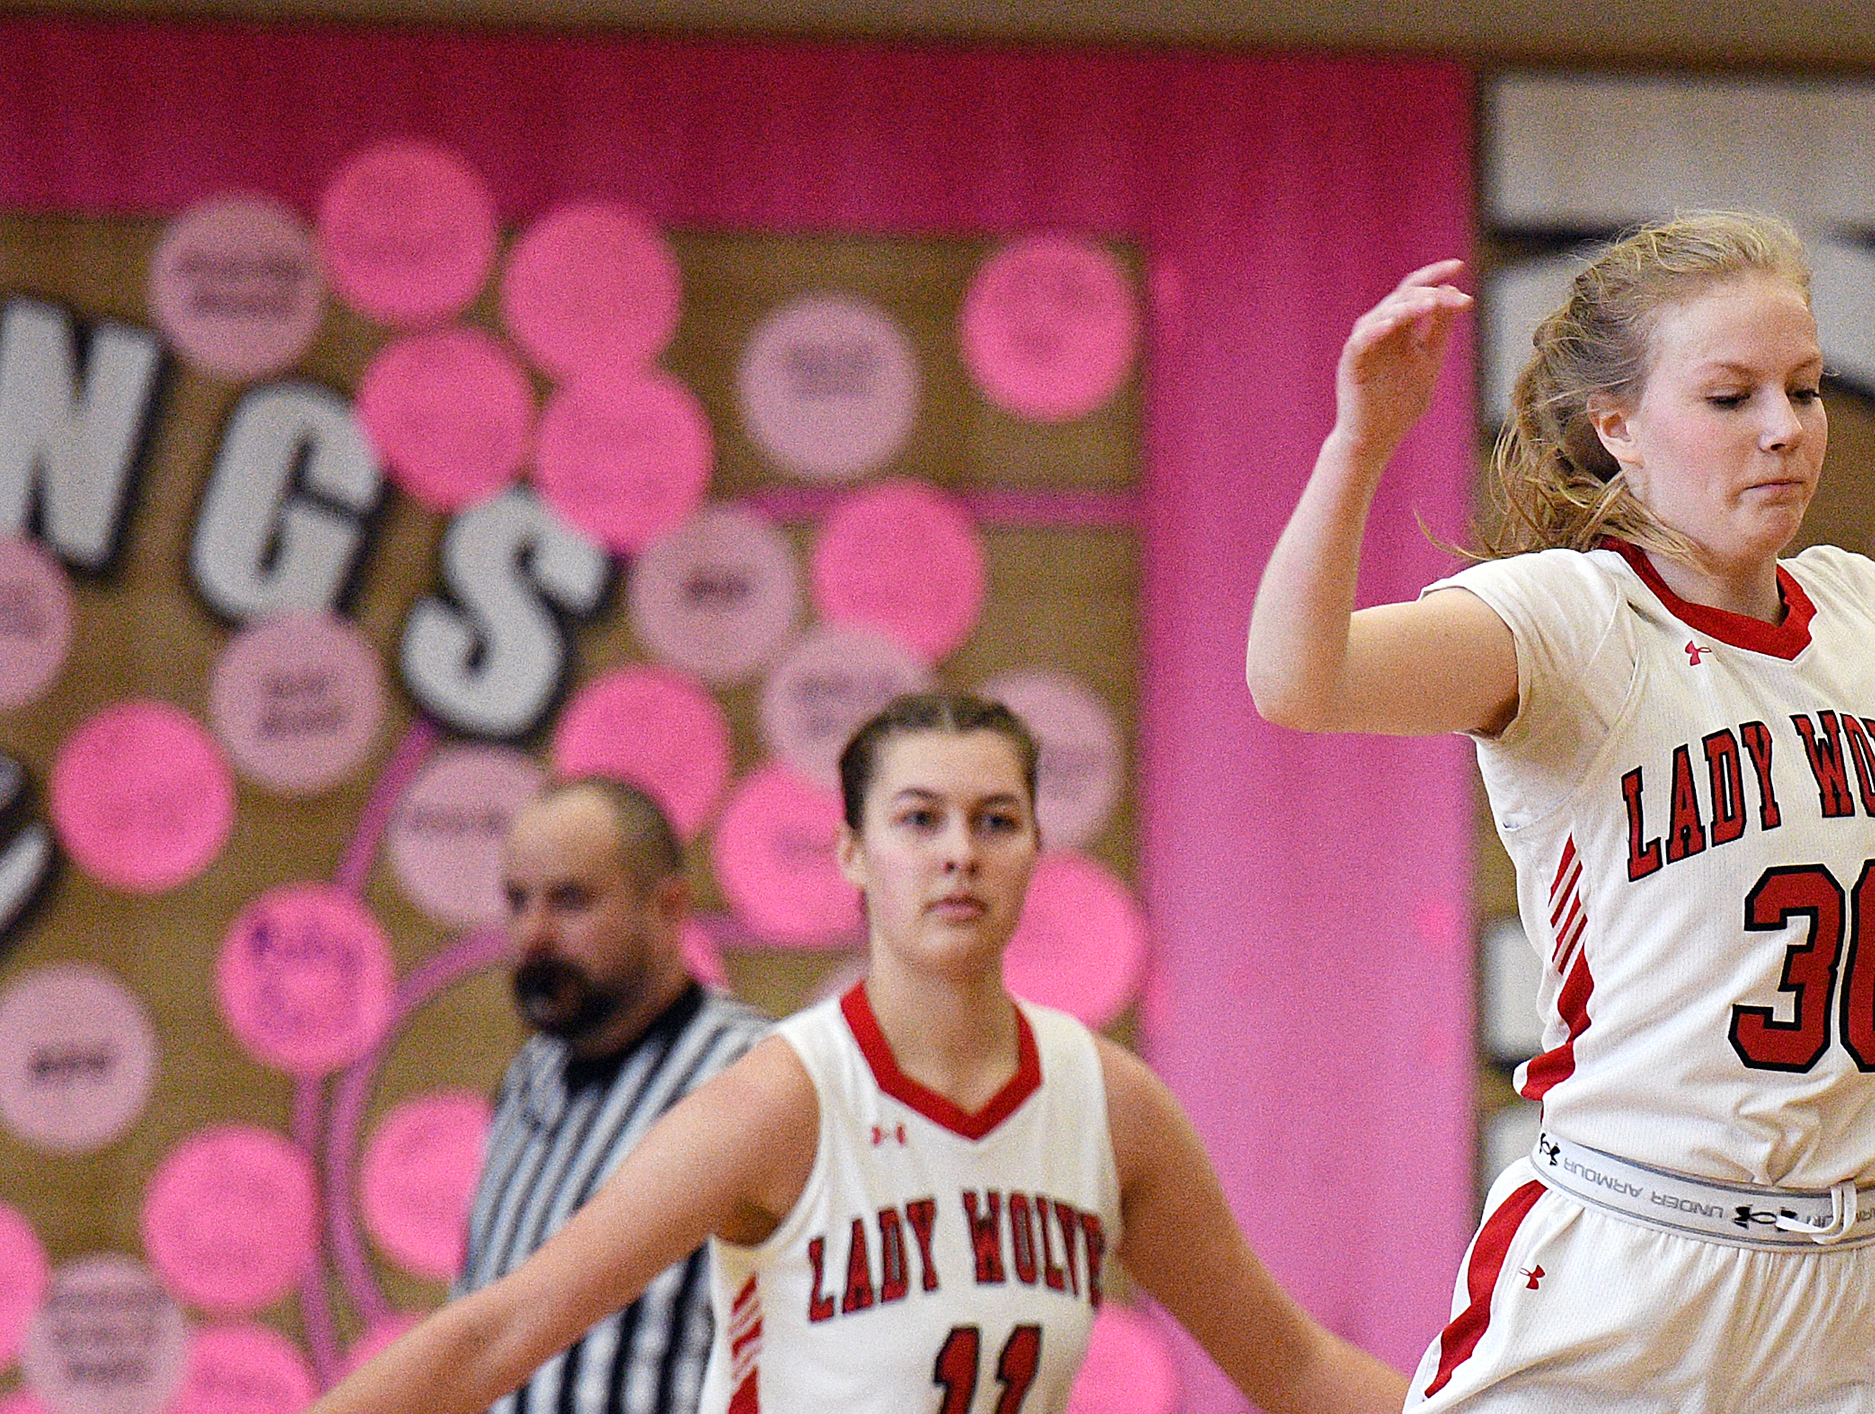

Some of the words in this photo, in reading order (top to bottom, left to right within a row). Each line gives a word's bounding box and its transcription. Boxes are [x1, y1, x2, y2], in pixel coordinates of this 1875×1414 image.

[1621, 719, 1782, 882] LADY
[1563, 1157, 1644, 1198] ARMOUR
[1650, 1190, 1724, 1219] UNDER
[807, 1197, 939, 1325] LADY
